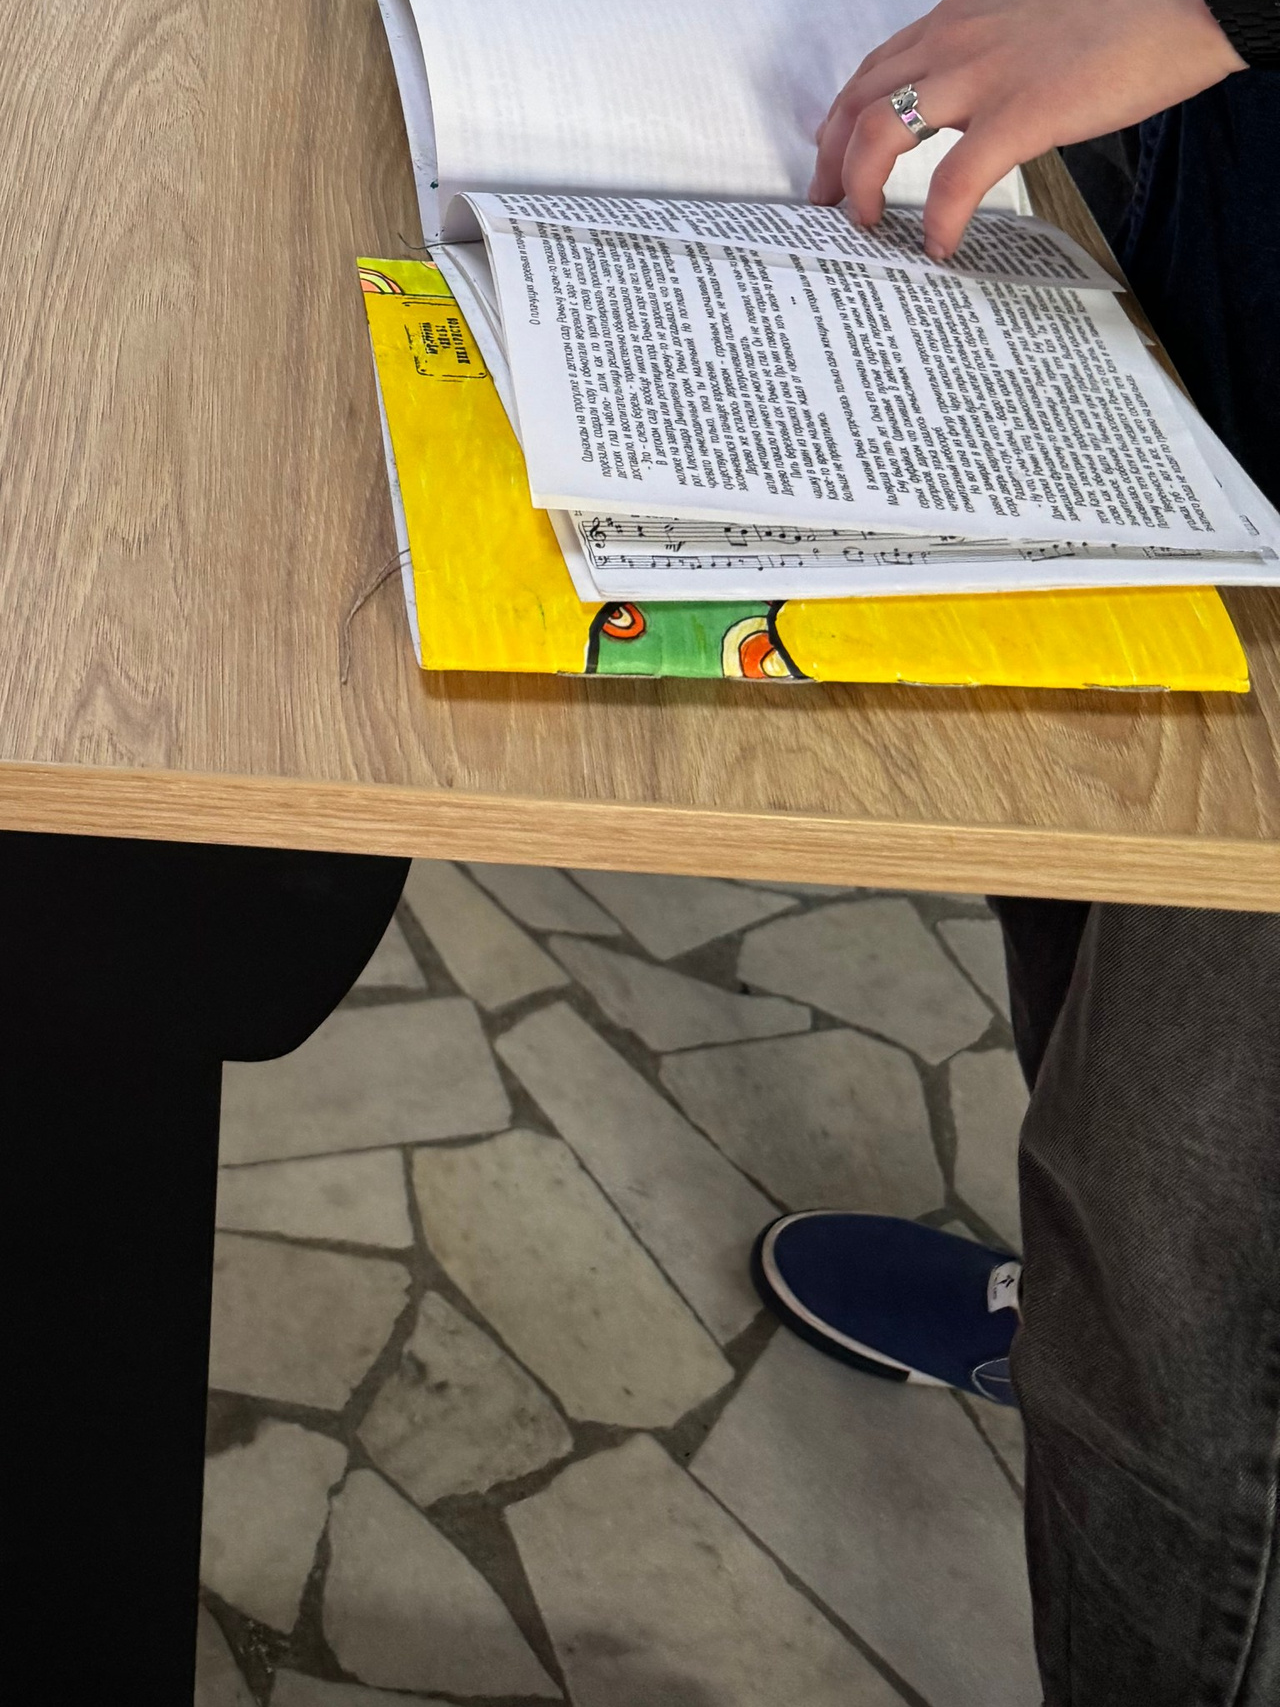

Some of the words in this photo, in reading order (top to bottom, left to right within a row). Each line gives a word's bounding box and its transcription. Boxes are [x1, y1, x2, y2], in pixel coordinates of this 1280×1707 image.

[554, 295, 567, 323] Ромычу
[838, 312, 849, 321] на
[559, 323, 571, 340] саду
[749, 325, 760, 335] не
[842, 322, 861, 357] выходили
[750, 336, 763, 347] Он
[562, 341, 577, 372] детском
[823, 349, 837, 367] одна
[746, 369, 763, 393] могло
[761, 368, 772, 377] не
[829, 368, 845, 393] только
[854, 358, 872, 389] комнаты
[569, 379, 586, 413] прогулке
[754, 393, 765, 403] не
[764, 378, 780, 404] Ромыч
[864, 390, 877, 402] его
[575, 414, 586, 424] на
[715, 402, 732, 433] панацее
[757, 403, 773, 429] ничего
[772, 405, 784, 418] сок
[838, 394, 861, 437] встречалась
[868, 404, 883, 422] Окна
[1141, 408, 1151, 417] на
[774, 419, 797, 459] березовый
[1146, 417, 1167, 442] гравию
[578, 425, 594, 462] Однажды
[767, 436, 785, 468] плакало
[853, 438, 868, 459] Ромы
[882, 439, 896, 456] пять
[1159, 443, 1171, 453] по
[725, 440, 749, 491] засомневался
[789, 460, 802, 478] Пить
[831, 461, 844, 472] не
[860, 459, 877, 484] жизни
[872, 455, 886, 470] тетя
[887, 457, 904, 478] было
[1164, 453, 1182, 473] ходят
[777, 469, 795, 496] Дерево
[835, 472, 854, 502] больше
[878, 471, 899, 506] Малярша
[896, 478, 910, 493] Ему
[945, 463, 975, 513] семиэтажный
[1175, 474, 1187, 483] не
[1180, 484, 1200, 502] рода
